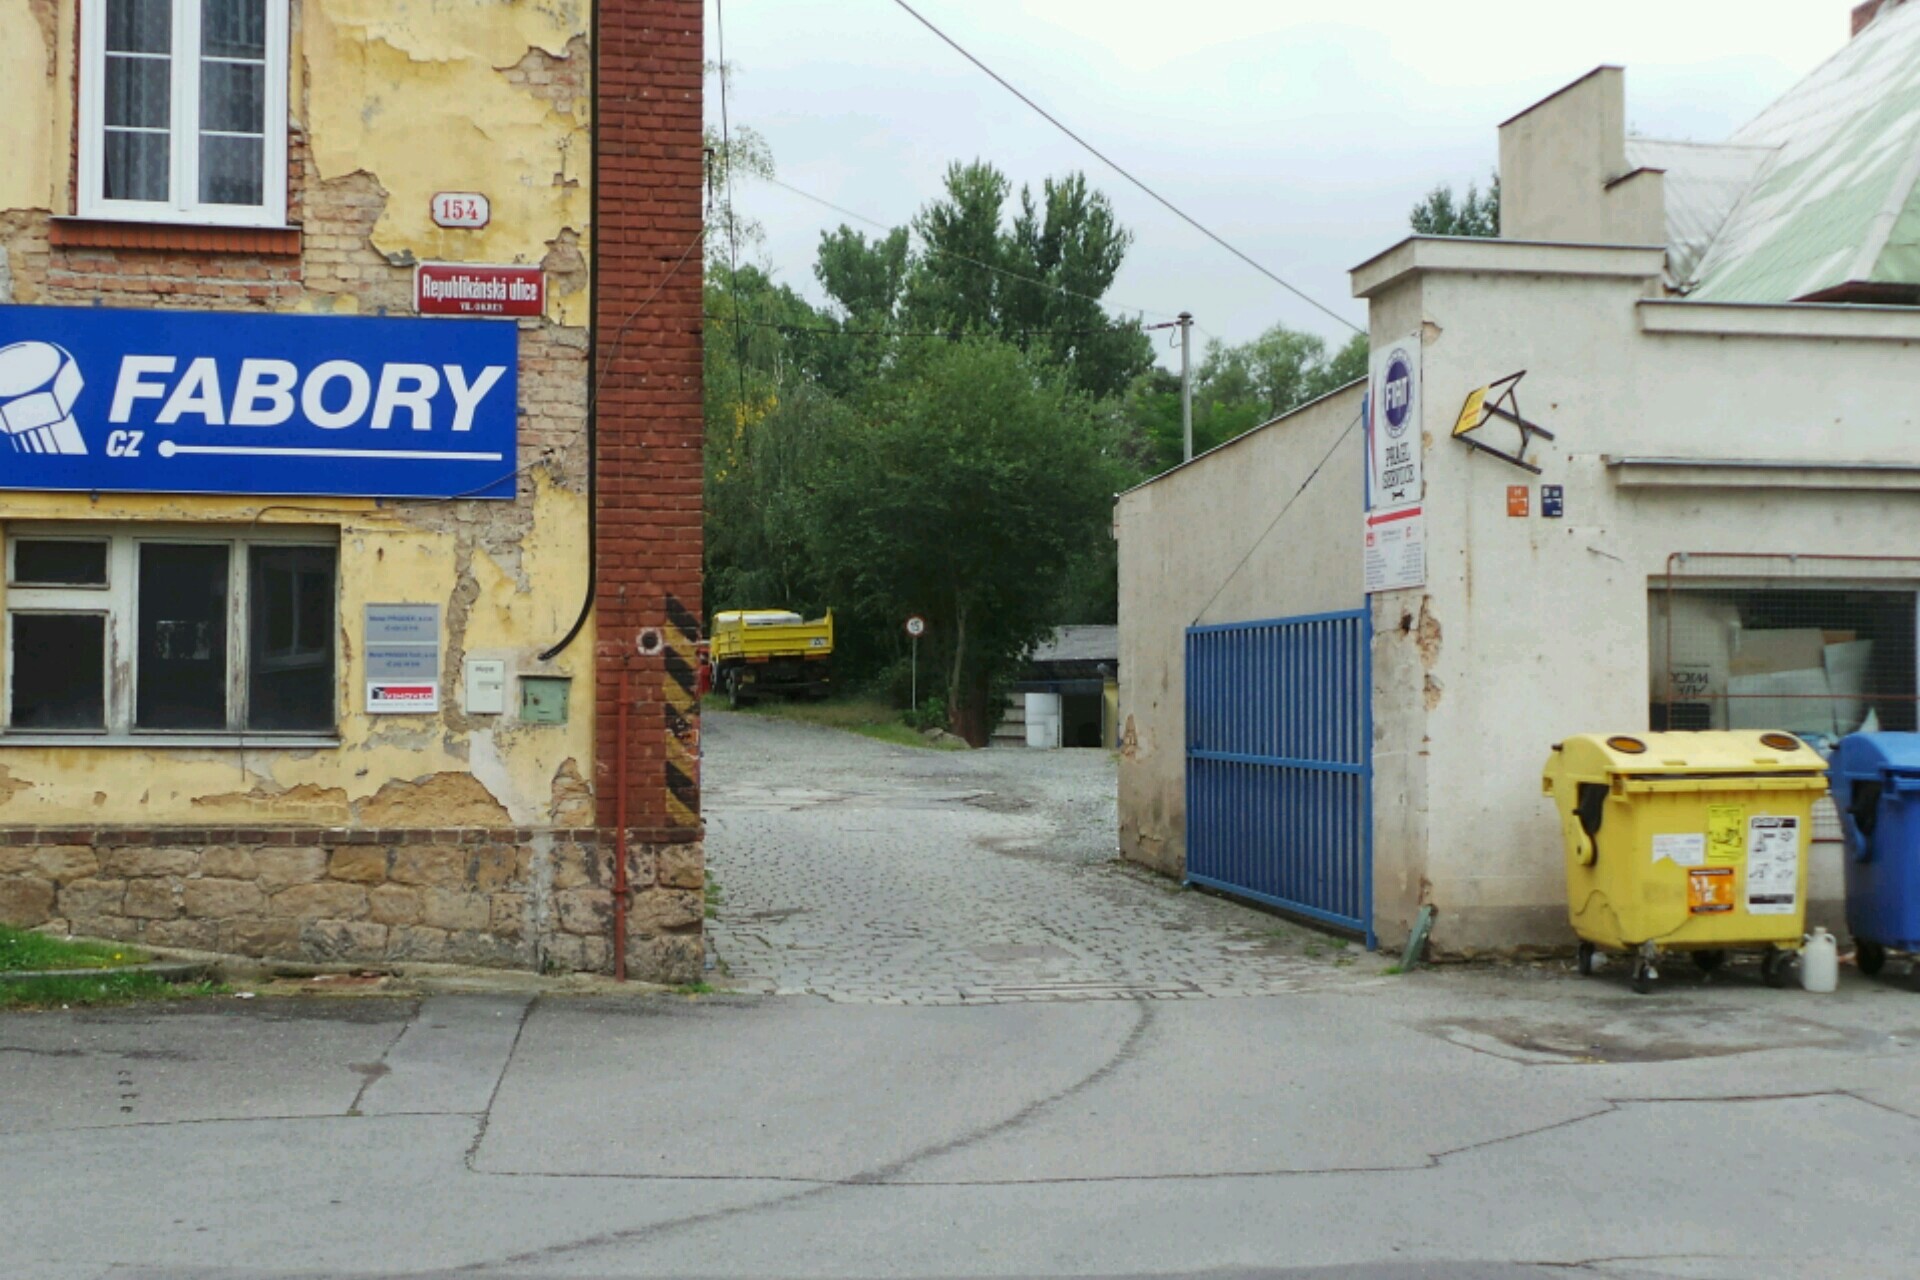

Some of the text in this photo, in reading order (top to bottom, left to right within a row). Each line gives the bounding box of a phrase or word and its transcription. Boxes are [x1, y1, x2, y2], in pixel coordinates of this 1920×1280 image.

[442, 199, 479, 220] 154
[422, 273, 538, 302] Republikánská ulice
[108, 354, 508, 431] FABORY
[105, 429, 145, 458] CZ
